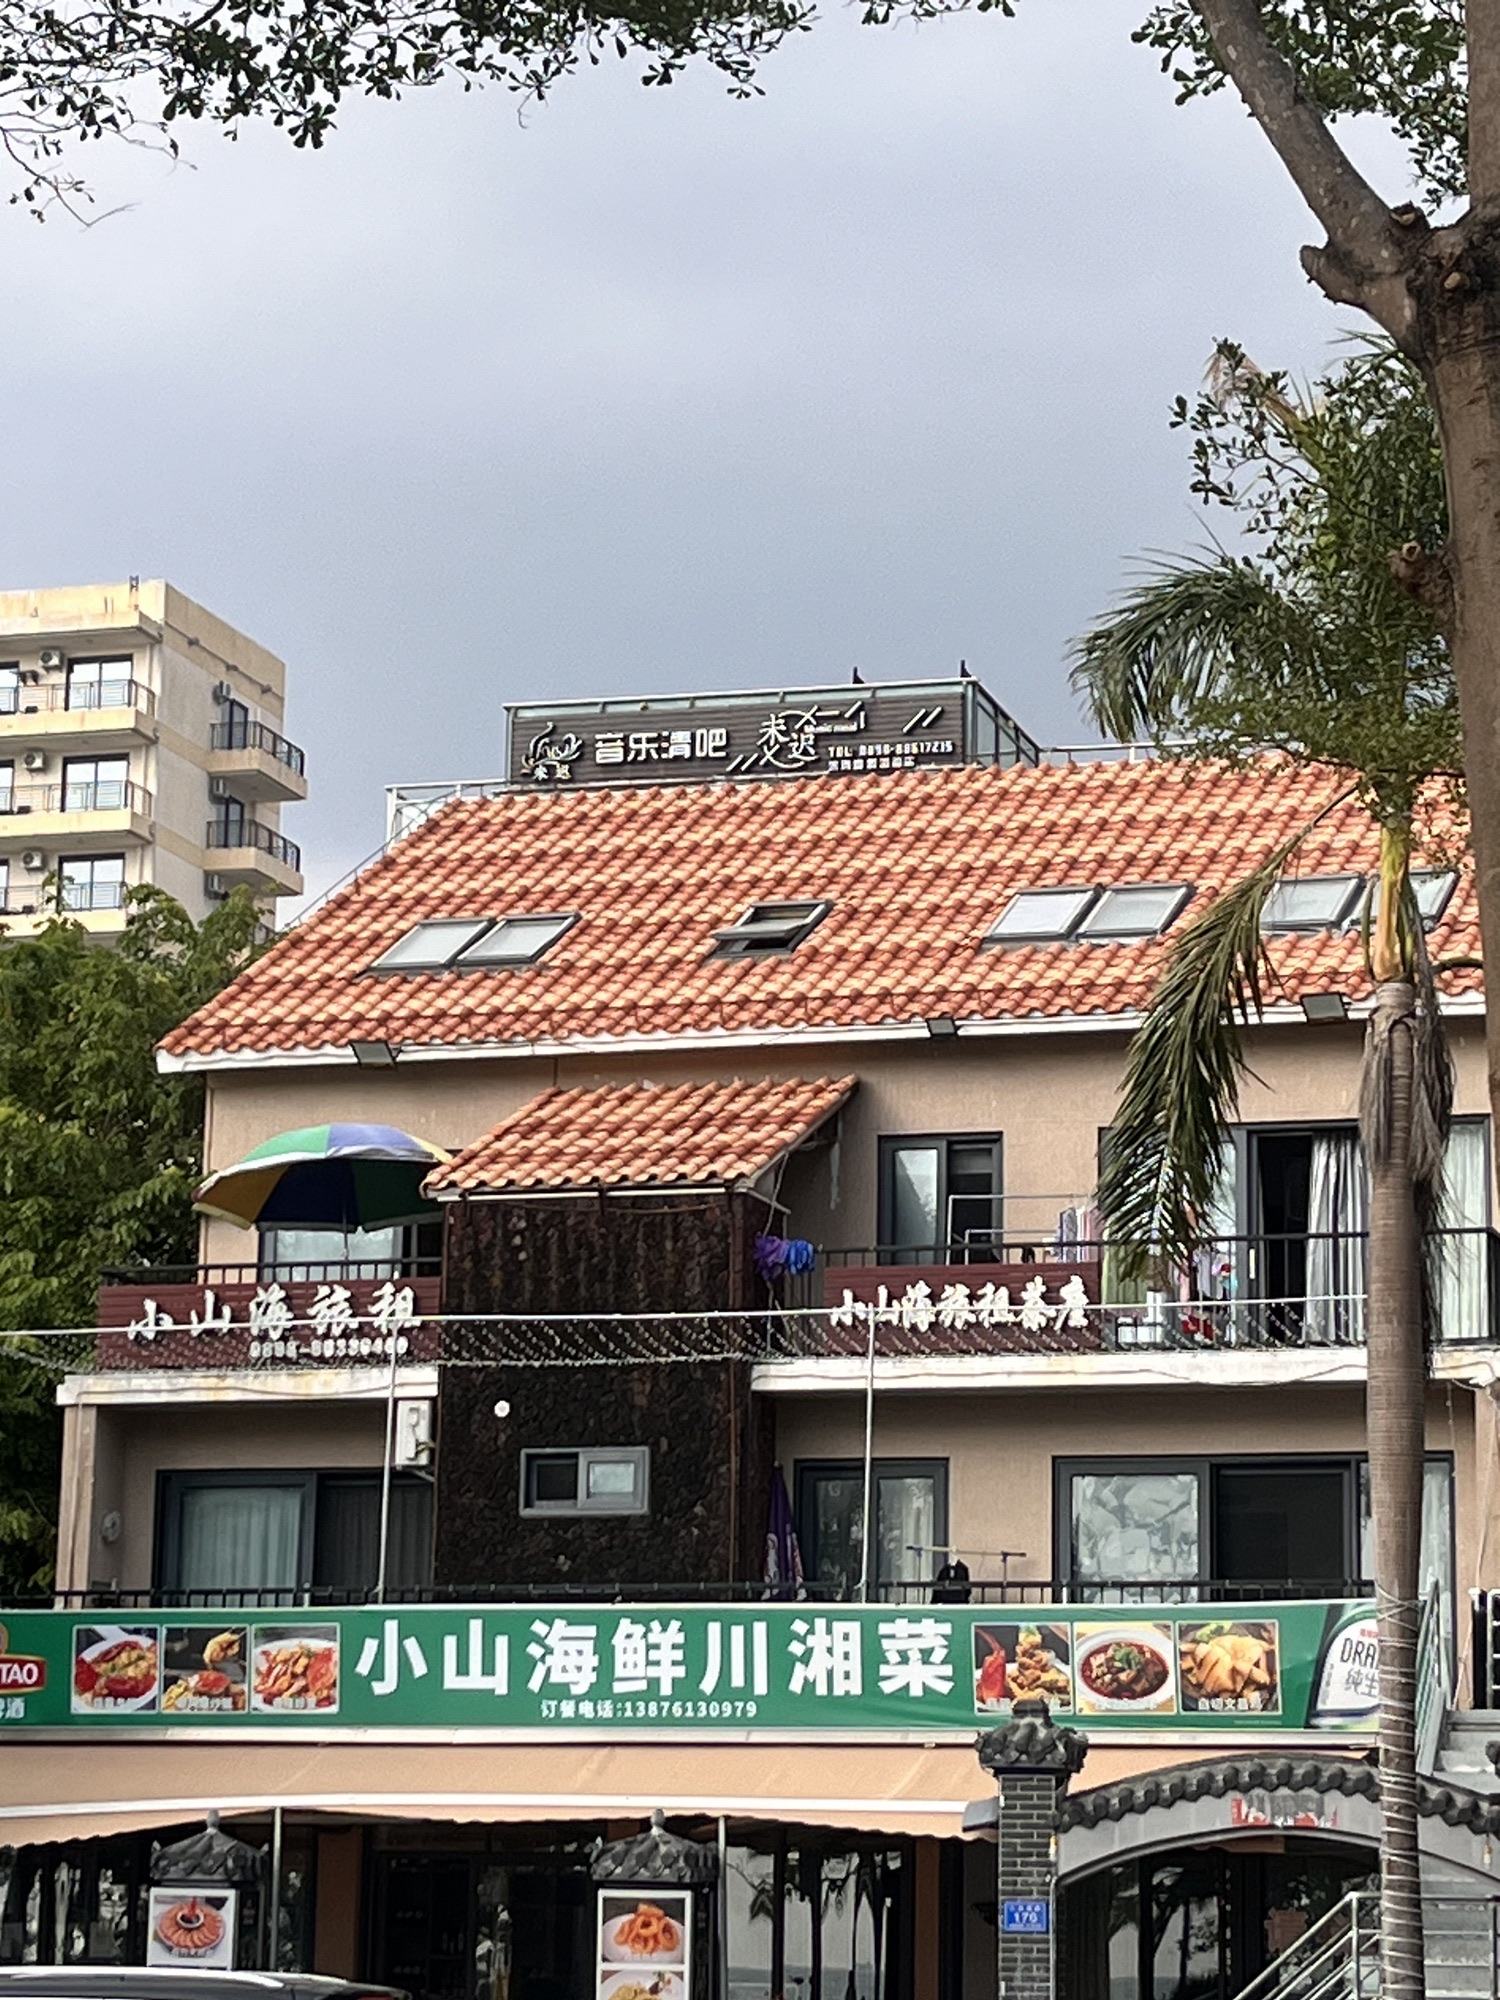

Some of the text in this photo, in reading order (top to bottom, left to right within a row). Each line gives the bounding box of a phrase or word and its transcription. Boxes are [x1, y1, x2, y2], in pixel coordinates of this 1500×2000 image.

[594, 727, 727, 764] 音乐清吧
[354, 1617, 956, 1698] 小山海鲜川湘菜
[1340, 1637, 1379, 1670] DRA
[540, 1699, 758, 1719] 订餐电话:13876130979
